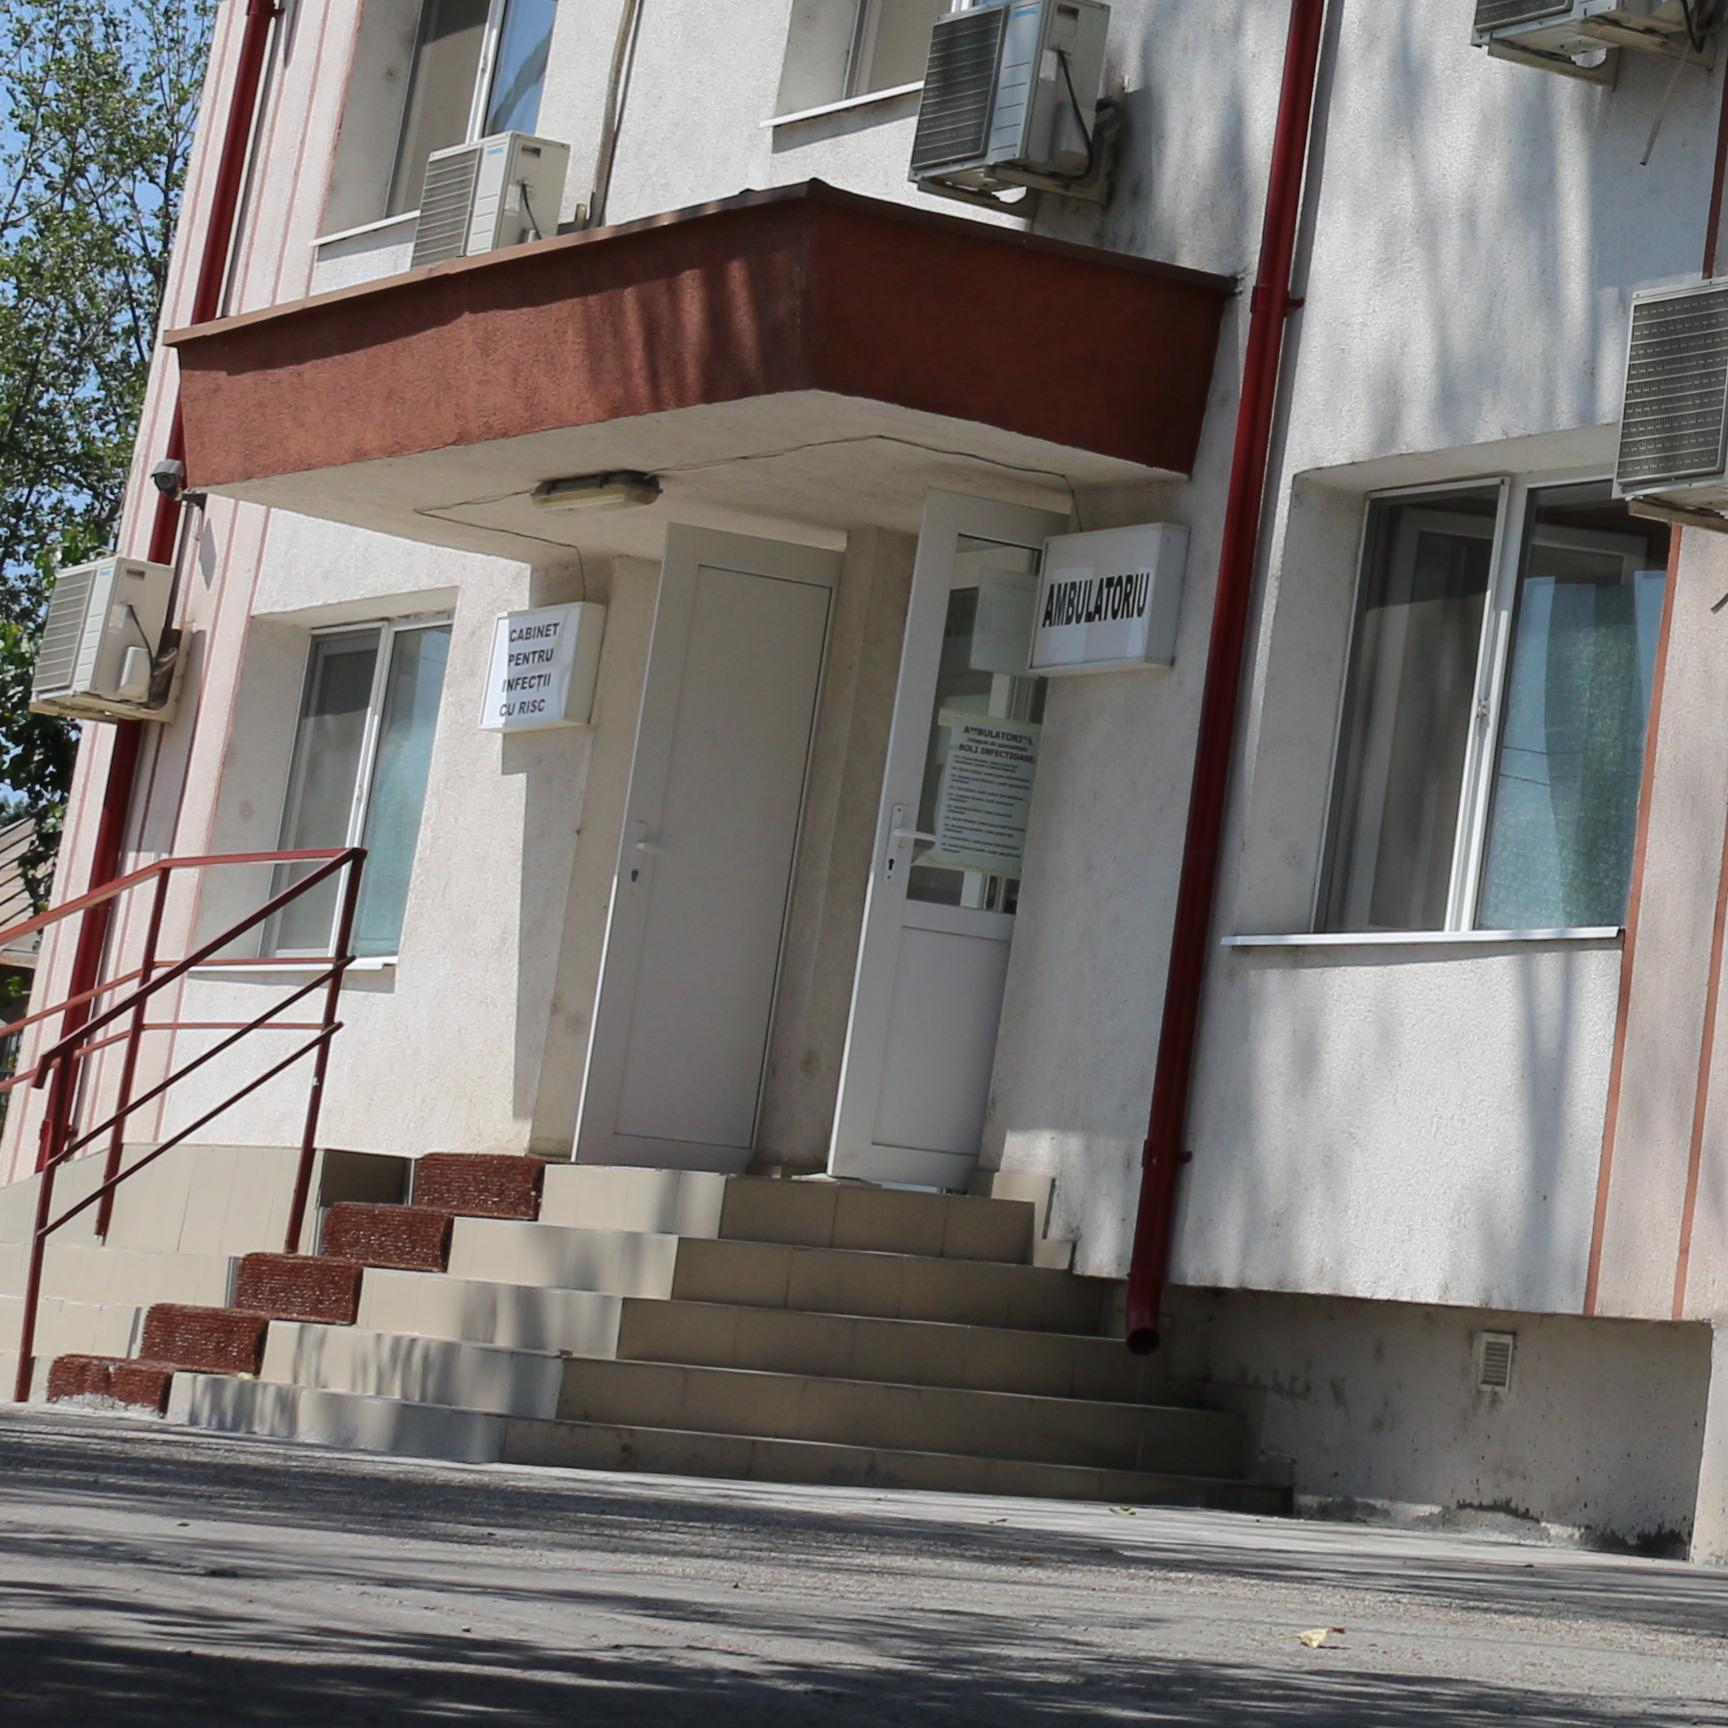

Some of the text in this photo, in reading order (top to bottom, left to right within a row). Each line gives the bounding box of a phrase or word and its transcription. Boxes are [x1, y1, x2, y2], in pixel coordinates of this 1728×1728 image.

[1042, 572, 1150, 628] AMBULATORIU
[509, 622, 560, 643] CABINET
[507, 648, 555, 667] PENTRU
[499, 698, 547, 717] CU RISC
